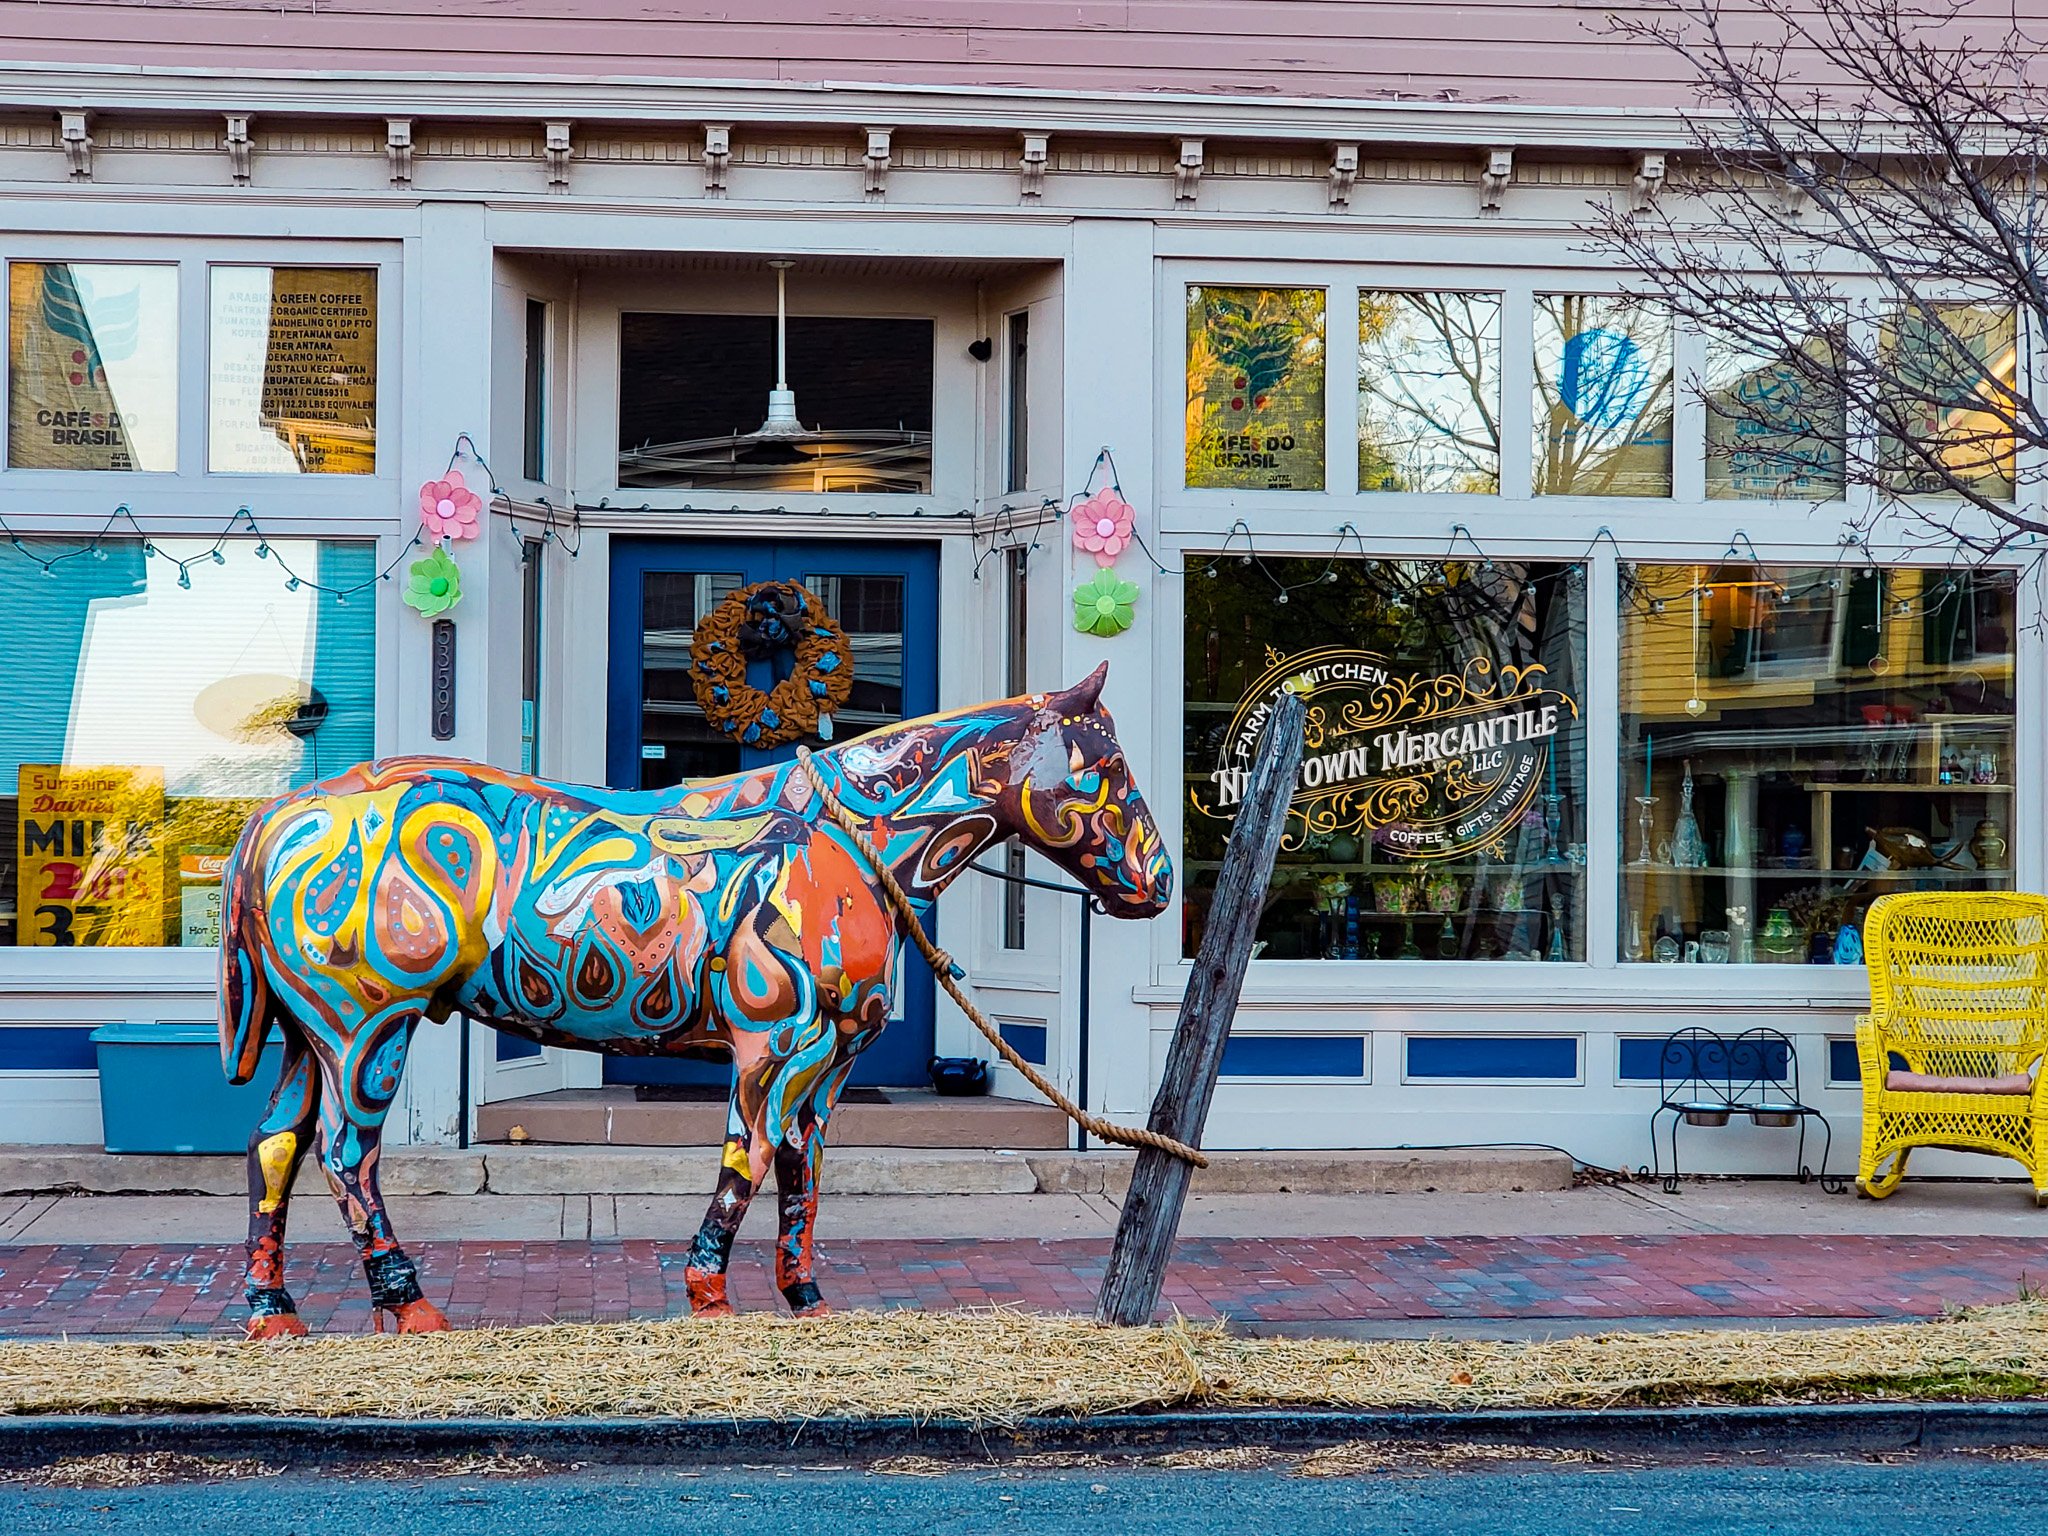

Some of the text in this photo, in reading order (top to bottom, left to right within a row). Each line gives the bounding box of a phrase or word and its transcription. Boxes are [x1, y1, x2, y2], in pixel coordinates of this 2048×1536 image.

[280, 293, 317, 304] GREEN
[320, 294, 362, 304] COFFEE
[276, 307, 318, 316] ORGANIC
[320, 307, 368, 317] CERTIFIED
[326, 319, 338, 328] G1
[340, 319, 352, 328] DP
[354, 320, 373, 328] FTO
[280, 330, 332, 339] PERTANIAN
[334, 331, 359, 340] GAYO
[296, 342, 333, 351] ANTARA
[315, 354, 345, 363] HATTA
[285, 365, 308, 374] TALU
[310, 365, 366, 374] KECAMATAN
[309, 400, 325, 409] LBS
[327, 401, 375, 410] EQUIVALEN
[290, 411, 339, 420] INDONESIA
[52, 429, 122, 446] BRASIL
[1266, 435, 1295, 452] DO
[1915, 474, 1980, 489] BRIL
[1235, 663, 1388, 758] FARM TO KITCHEN
[1210, 705, 1559, 807] NOWN MERCANTILE
[1389, 754, 1534, 844] COFFEE GIFTS VINTAGE
[40, 862, 84, 900] 2
